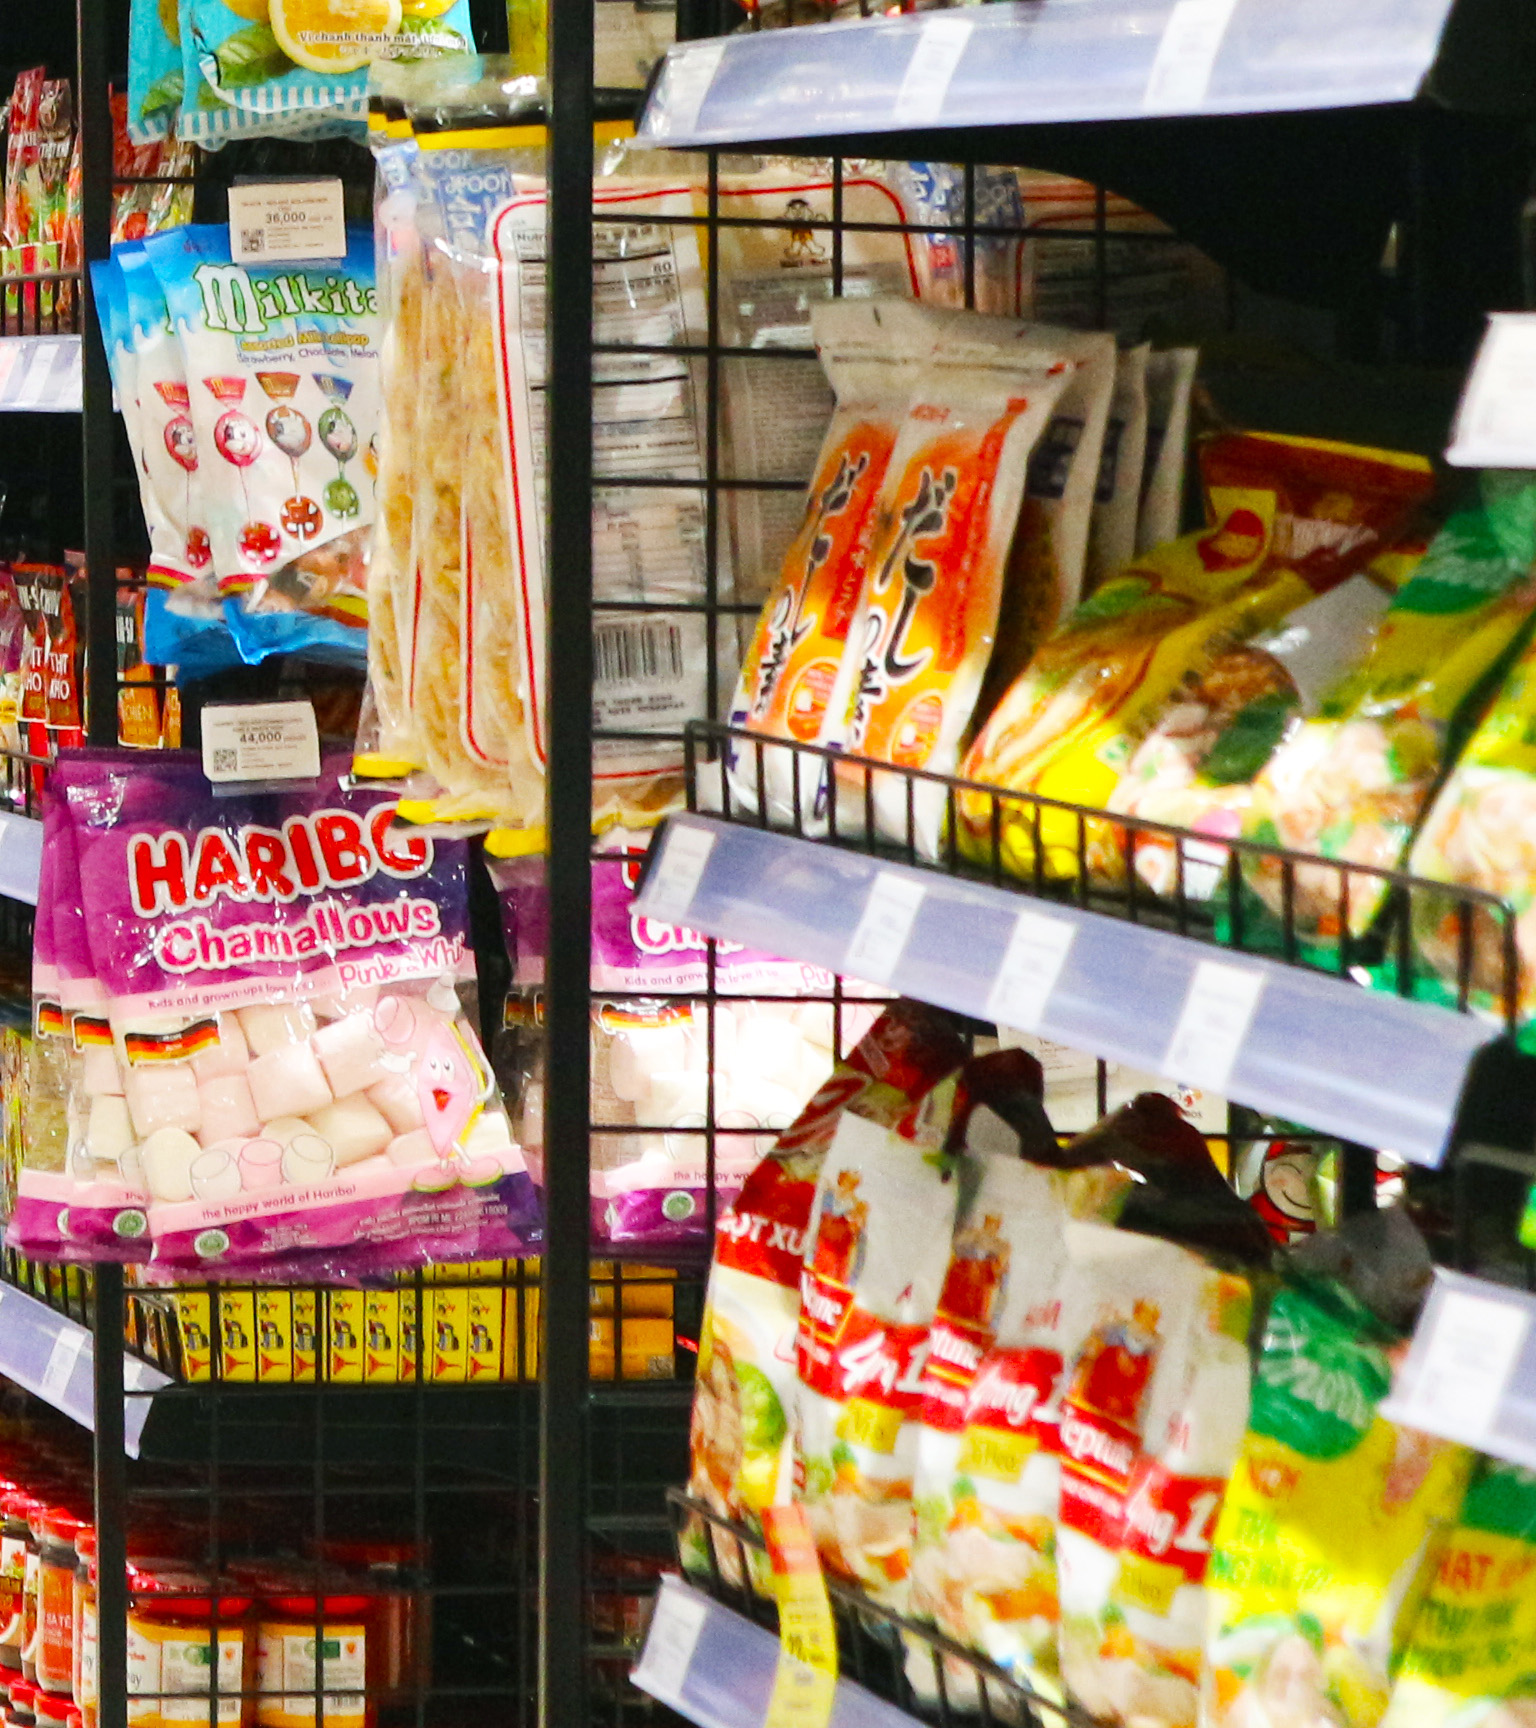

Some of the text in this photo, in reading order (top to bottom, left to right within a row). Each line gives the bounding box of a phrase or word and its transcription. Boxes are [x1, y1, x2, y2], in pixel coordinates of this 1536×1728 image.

[314, 32, 352, 43] chanh
[265, 212, 307, 225] 36,000
[193, 262, 378, 335] Milkita
[239, 731, 283, 744] 44,000
[160, 901, 438, 967] Chamallows
[339, 931, 466, 992] Pink Whi
[650, 975, 673, 986] and
[148, 996, 173, 1010] Kids
[176, 994, 199, 1007] and
[202, 983, 265, 1006] grown-ups
[202, 1184, 357, 1220] the happy world of Haribo!
